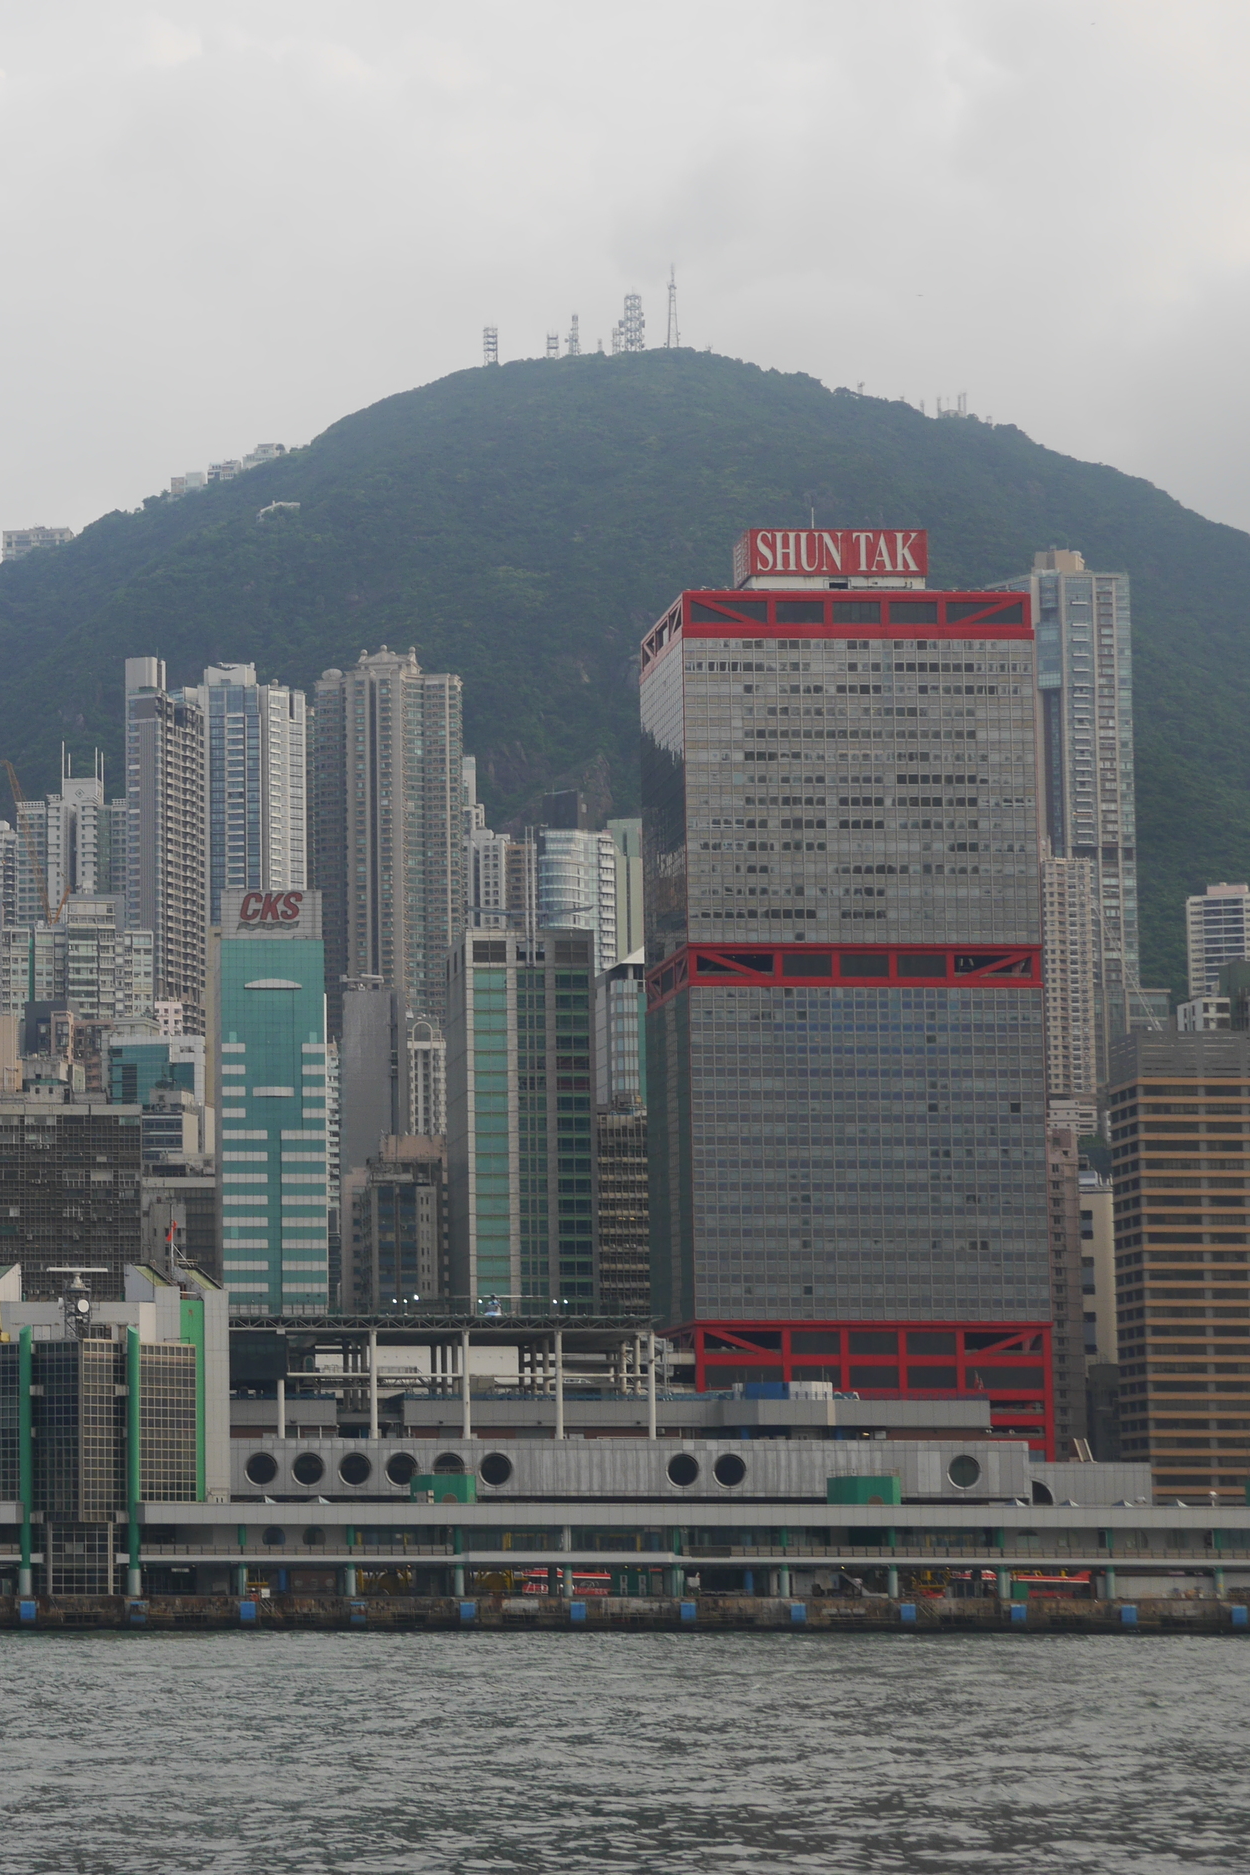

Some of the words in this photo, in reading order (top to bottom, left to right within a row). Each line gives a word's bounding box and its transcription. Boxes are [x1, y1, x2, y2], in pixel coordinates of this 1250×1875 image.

[756, 530, 843, 572] SHUN
[852, 531, 920, 572] TAK
[240, 891, 303, 922] CKS
